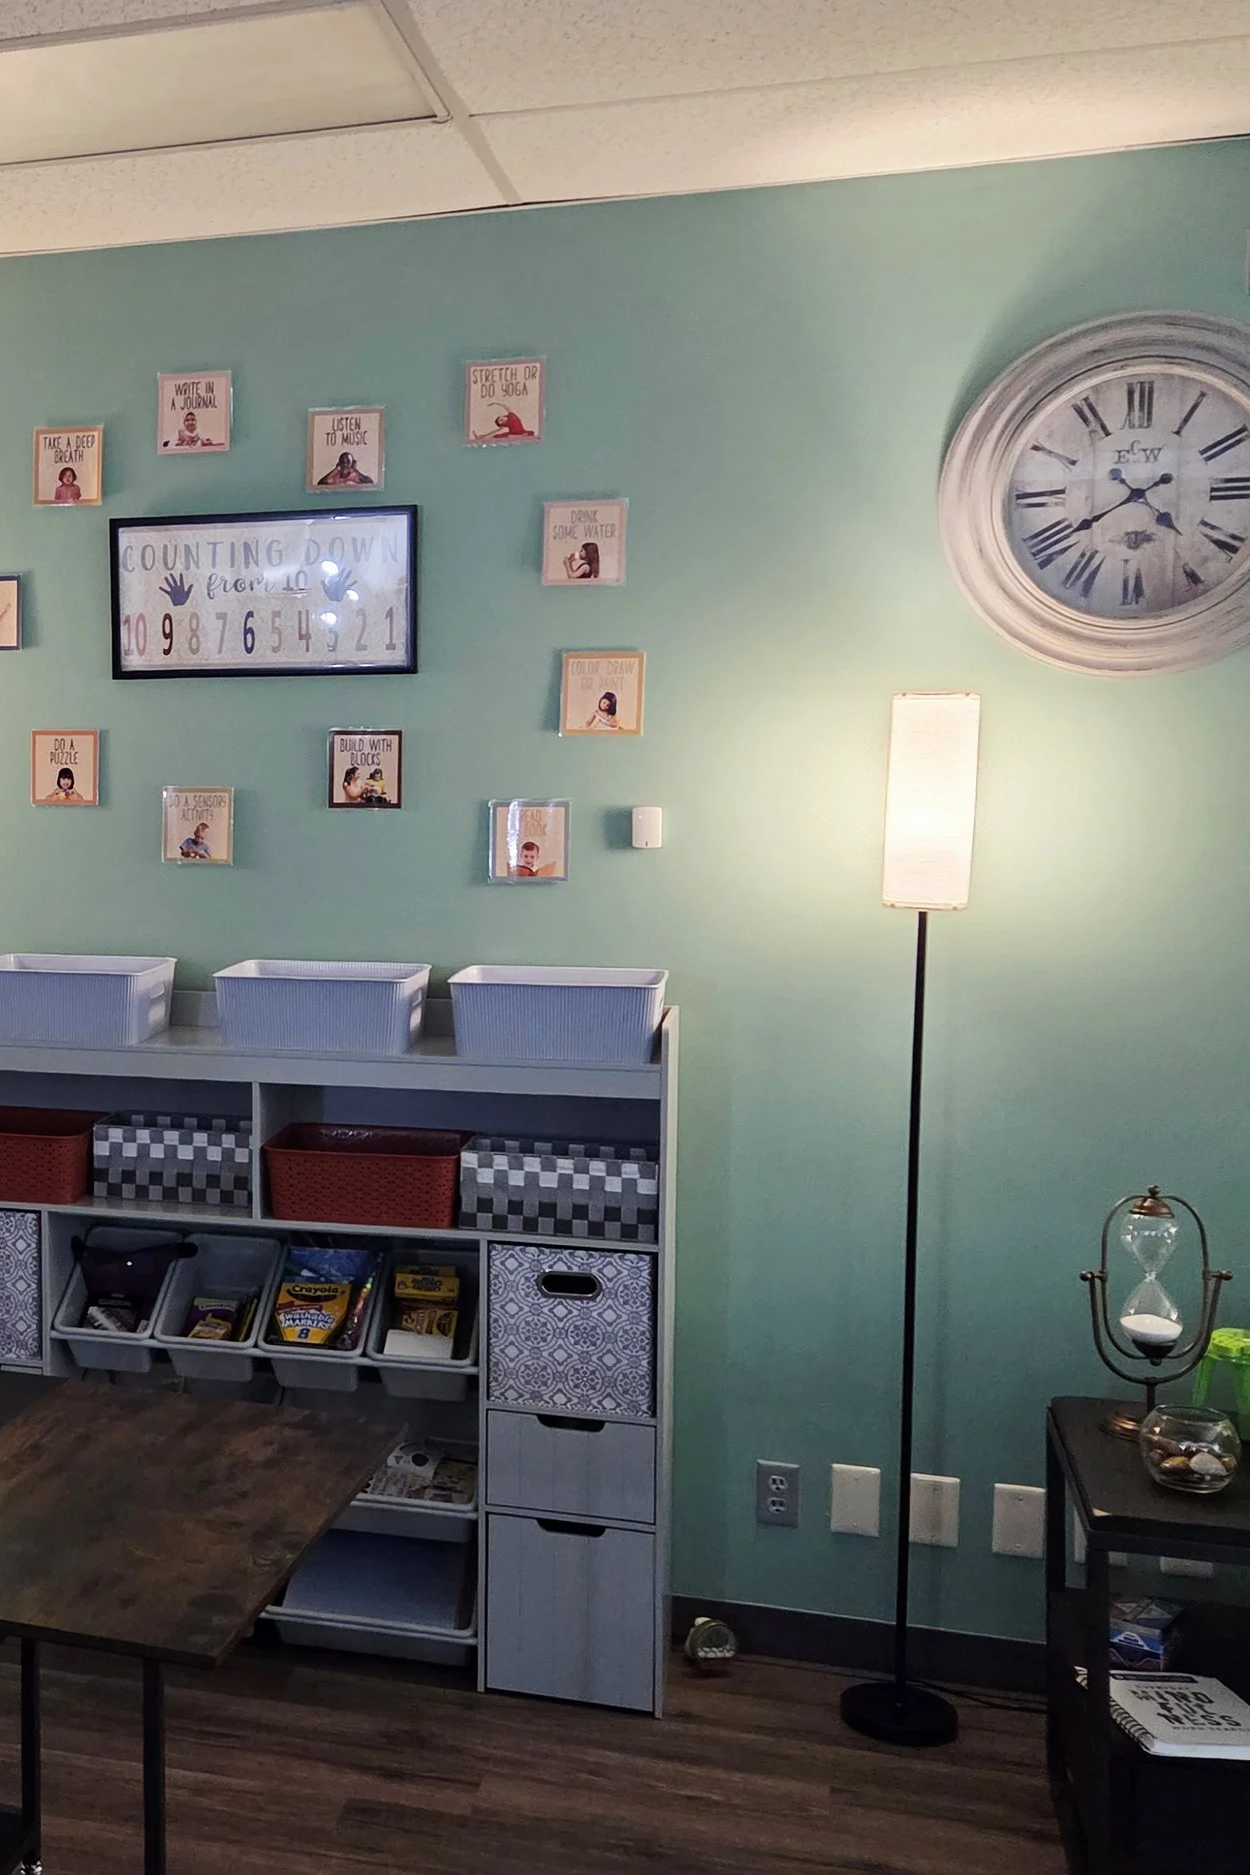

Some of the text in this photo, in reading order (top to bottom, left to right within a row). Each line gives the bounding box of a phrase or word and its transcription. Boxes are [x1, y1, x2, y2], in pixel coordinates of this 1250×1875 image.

[472, 366, 538, 384] STRETCH OR
[175, 381, 214, 396] WRITE IN
[481, 382, 528, 398] DO YOGA
[171, 395, 217, 410] A JOURNAL
[332, 416, 361, 432] LISTEN
[43, 434, 96, 450] TAKE A DEEP
[325, 431, 368, 446] TO MUSIC
[54, 449, 84, 464] BREATH
[571, 509, 599, 525] DRINK
[553, 523, 616, 540] SOME WATER
[121, 536, 399, 573] COUNTING DOWN
[206, 571, 309, 600] from 10
[123, 612, 147, 657] 10
[162, 613, 174, 656] 9
[187, 612, 200, 655] 8
[215, 612, 228, 655] 7
[243, 611, 255, 654] 6
[271, 611, 283, 653] 5
[297, 609, 312, 652] 4
[355, 608, 368, 651] 2
[385, 607, 396, 650] 1
[54, 738, 75, 751] DO A
[340, 738, 392, 752] BUILD WITH
[50, 751, 78, 765] PUZZLE
[350, 752, 381, 766] BLOCKS
[183, 795, 189, 808] A
[193, 794, 226, 809] SENSORY
[291, 1284, 339, 1295] Crayola
[297, 1328, 310, 1339] 8
[1129, 1689, 1214, 1704] MIND
[1156, 1712, 1242, 1726] NESS
